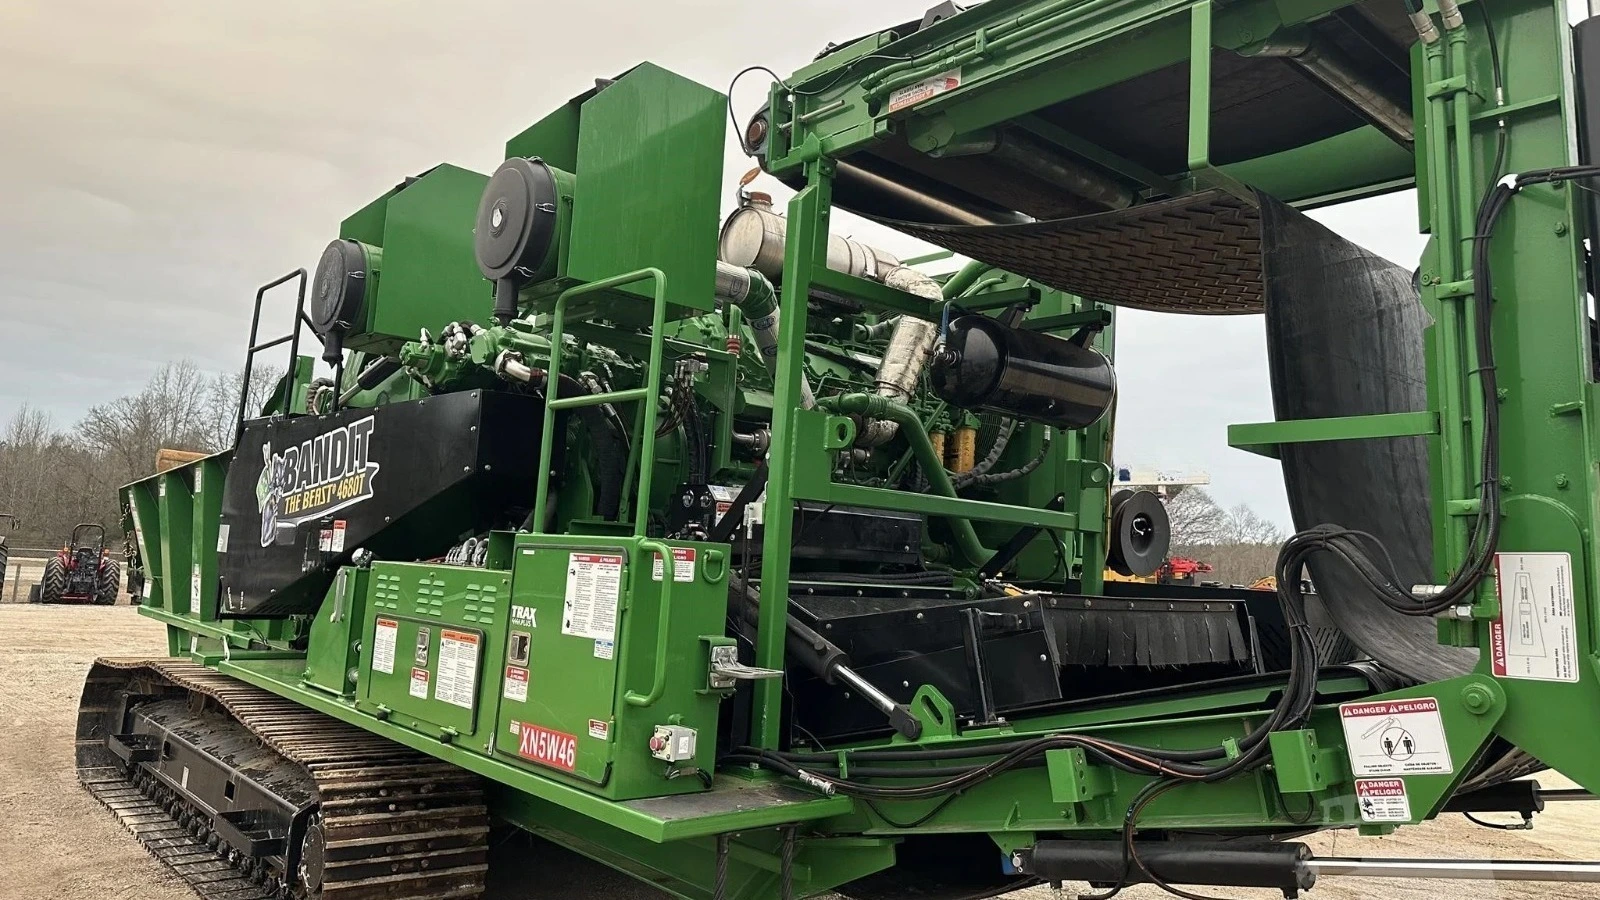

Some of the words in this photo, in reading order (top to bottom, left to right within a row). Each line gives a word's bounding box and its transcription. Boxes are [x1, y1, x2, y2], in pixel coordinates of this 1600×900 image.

[282, 415, 375, 497] BANDIT
[284, 493, 301, 514] THE
[337, 473, 366, 500] 4680T
[511, 605, 537, 628] TRAX
[1495, 623, 1503, 657] DANGER
[1352, 706, 1387, 715] DANGER
[1398, 702, 1436, 712] PELIGRO
[520, 726, 575, 768] XN5W46
[1369, 788, 1403, 796] PELIGRO
